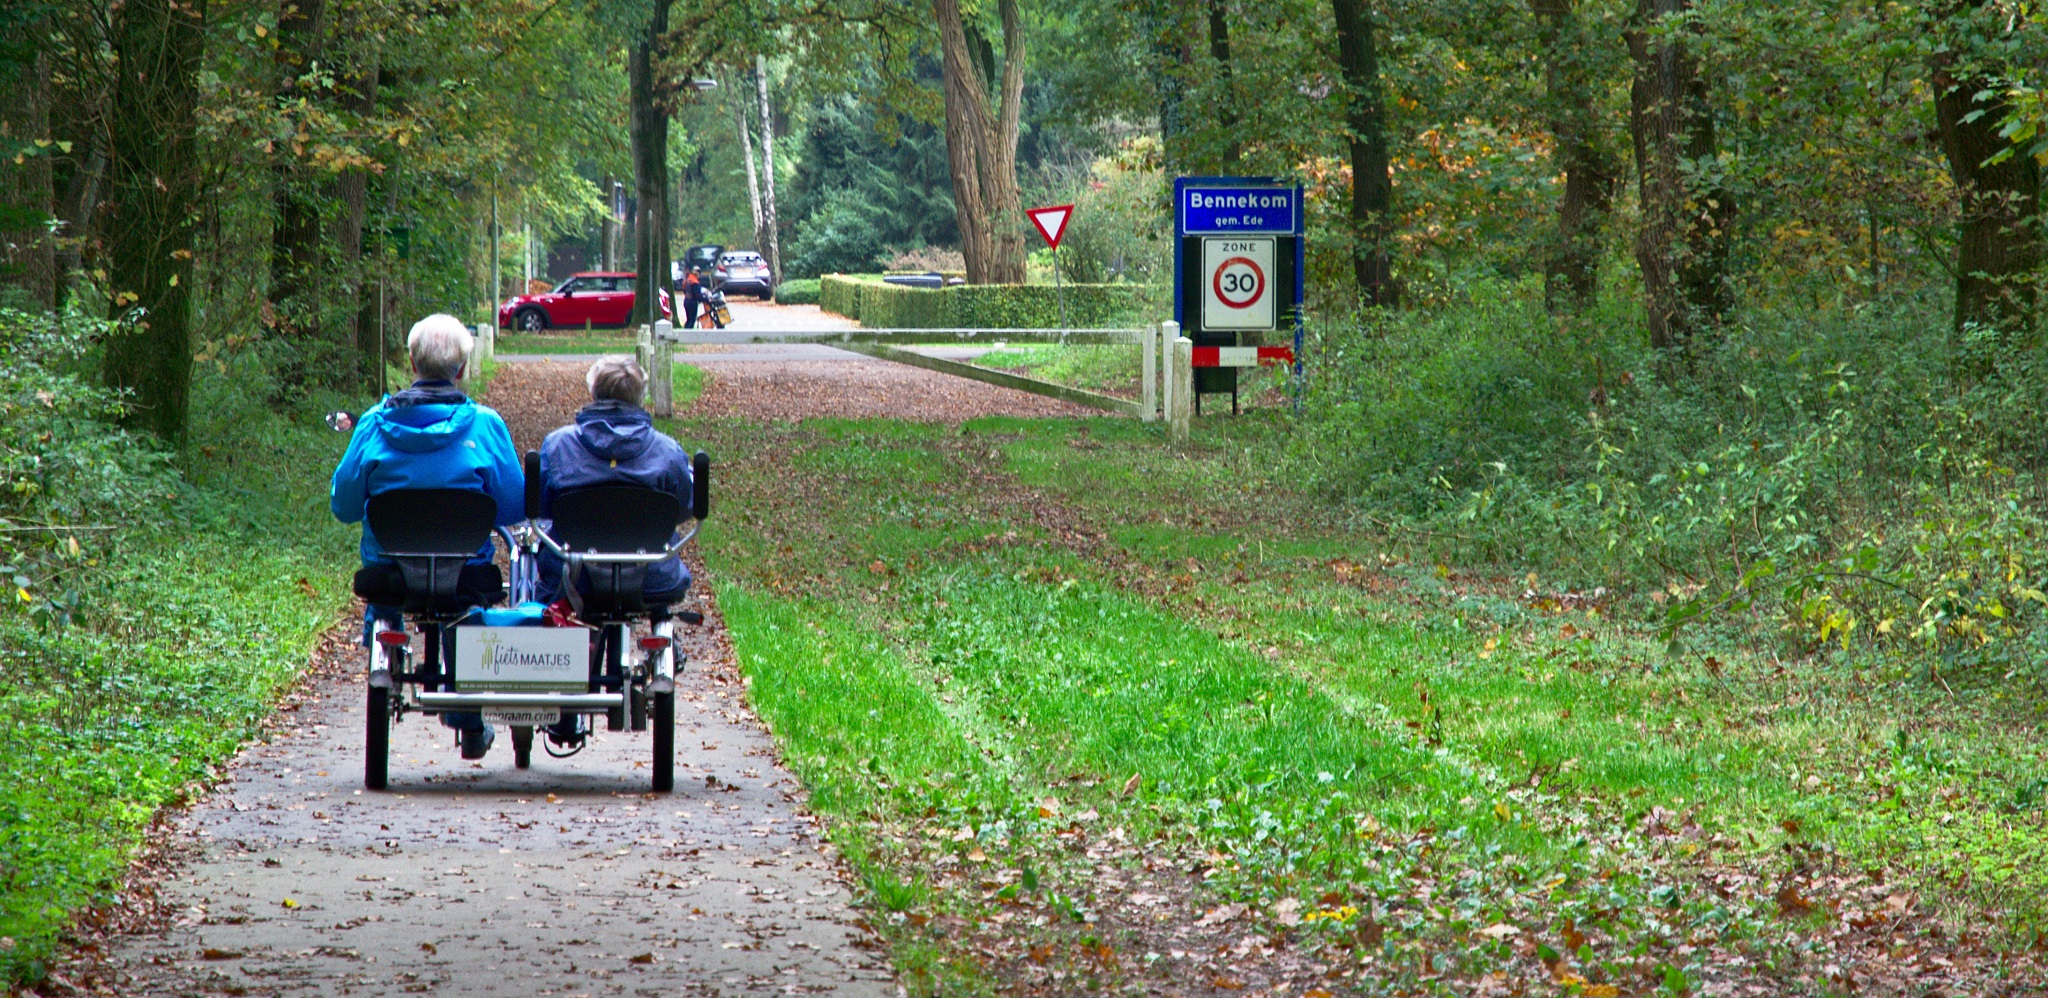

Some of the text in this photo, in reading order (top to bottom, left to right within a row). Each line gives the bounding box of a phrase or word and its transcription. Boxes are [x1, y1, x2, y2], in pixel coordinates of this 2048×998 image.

[1191, 192, 1287, 208] Bennekom
[1215, 215, 1263, 227] gem. Ede
[1223, 243, 1256, 252] ZONE
[1223, 273, 1255, 293] 30
